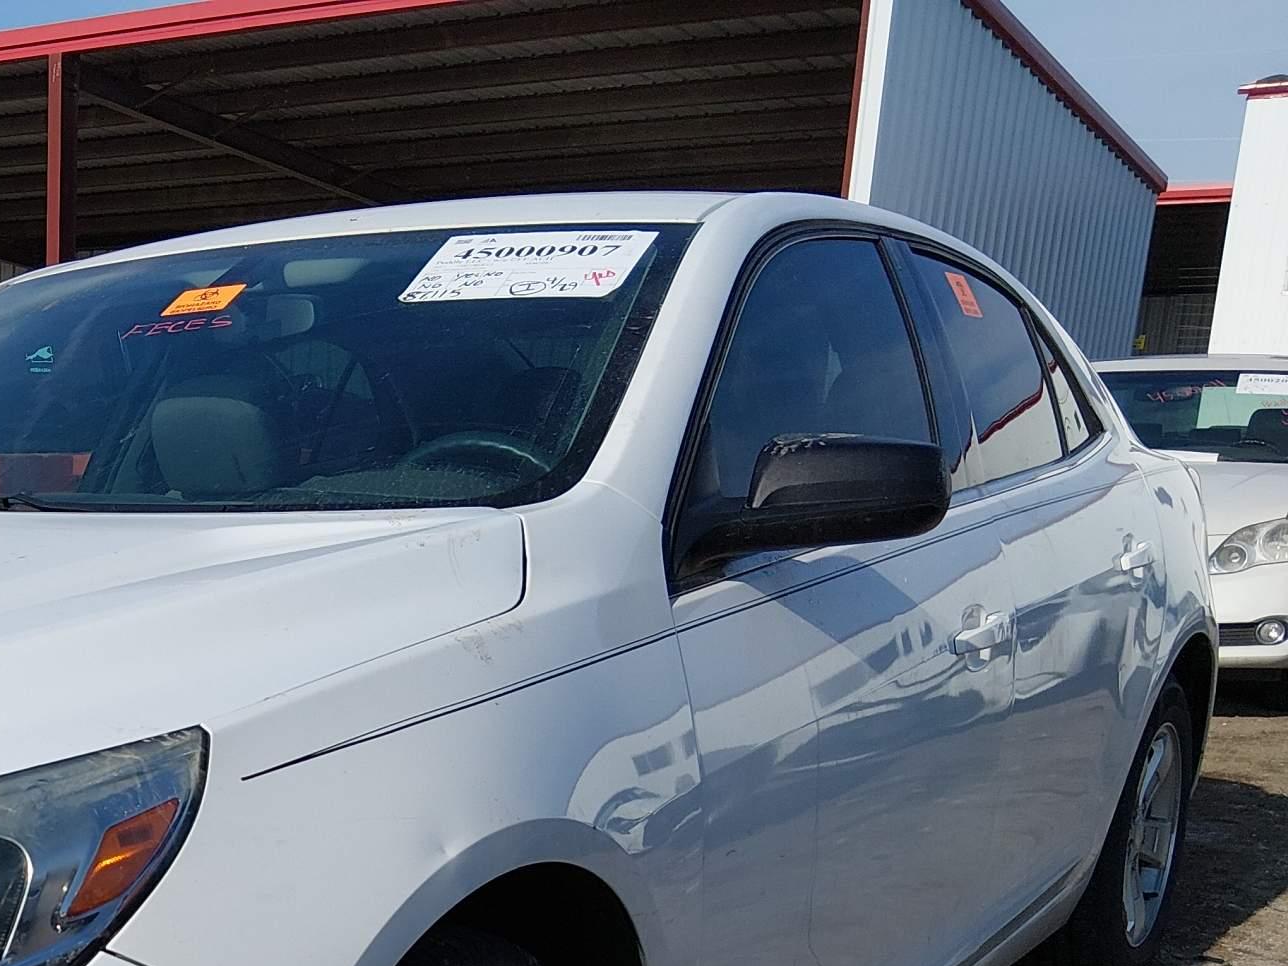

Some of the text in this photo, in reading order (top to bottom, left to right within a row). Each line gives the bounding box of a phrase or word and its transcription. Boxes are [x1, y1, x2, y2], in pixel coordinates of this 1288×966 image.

[454, 244, 622, 260] 45000907
[458, 279, 484, 288] NO
[121, 315, 232, 339] FECES
